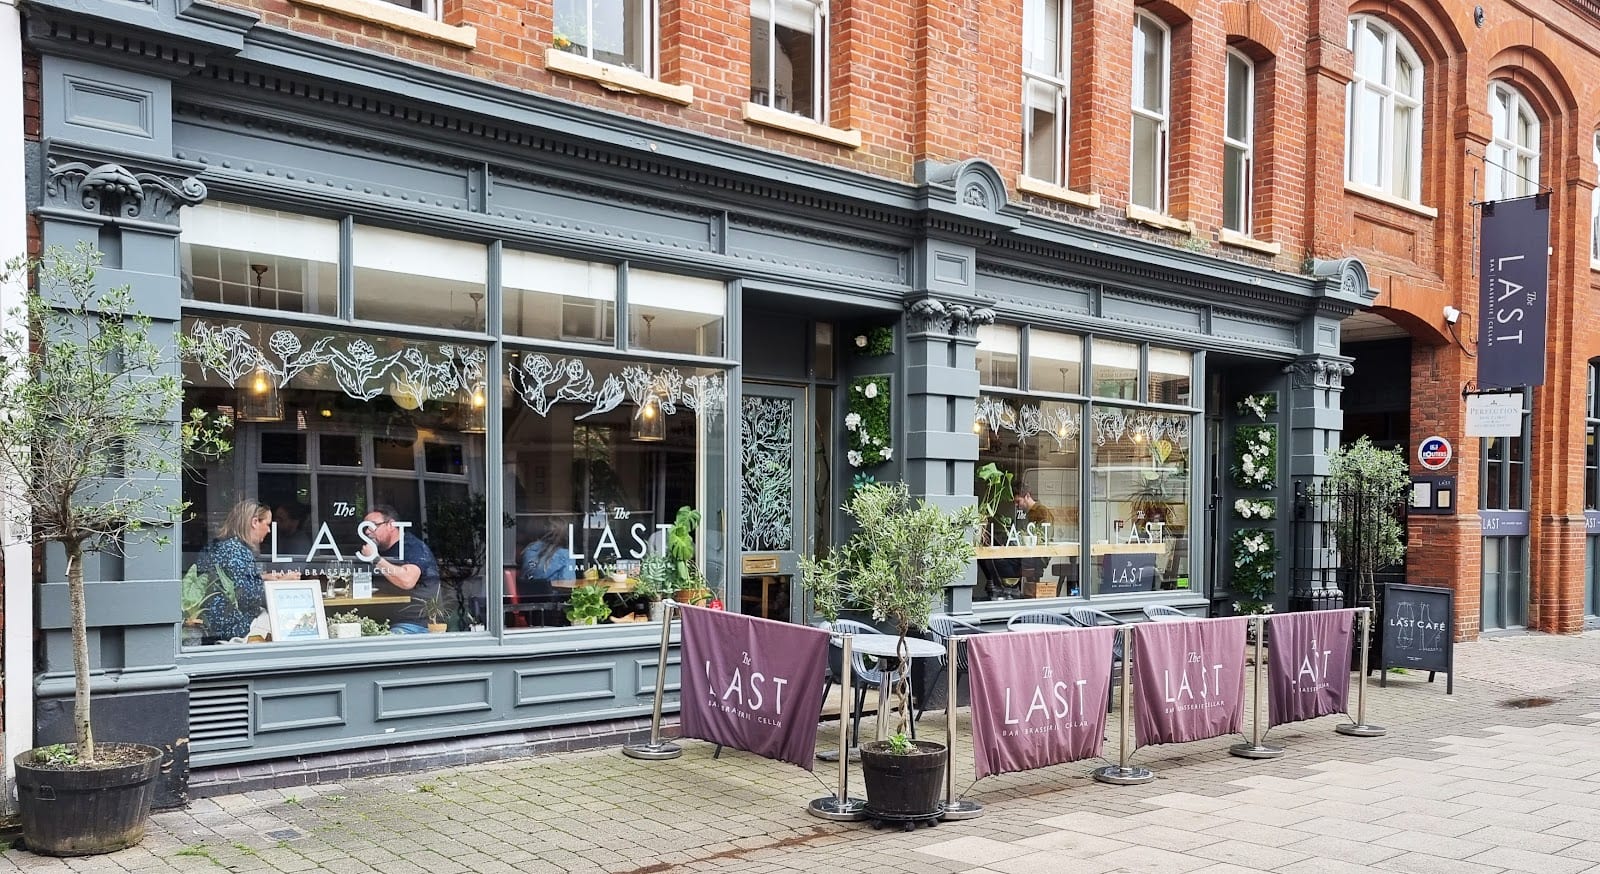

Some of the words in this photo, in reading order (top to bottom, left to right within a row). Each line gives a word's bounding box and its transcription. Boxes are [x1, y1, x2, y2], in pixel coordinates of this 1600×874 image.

[1497, 255, 1525, 344] LAST
[1526, 291, 1537, 306] The
[333, 502, 356, 517] The
[613, 507, 631, 520] The
[1016, 509, 1027, 520] The
[1136, 510, 1146, 519] The
[1482, 517, 1500, 530] LAST
[1585, 517, 1597, 529] AST
[990, 522, 1051, 549] LAST
[1115, 521, 1166, 545] LAST
[271, 521, 413, 563] LAST
[568, 523, 673, 560] LAST
[305, 567, 363, 577] BRASSERIE
[1112, 567, 1145, 583] LAST
[1390, 618, 1415, 627] LAST
[1417, 621, 1446, 631] CAFÉ
[1188, 651, 1202, 663] The
[1164, 664, 1223, 703] LAST
[1004, 679, 1087, 725] LAST
